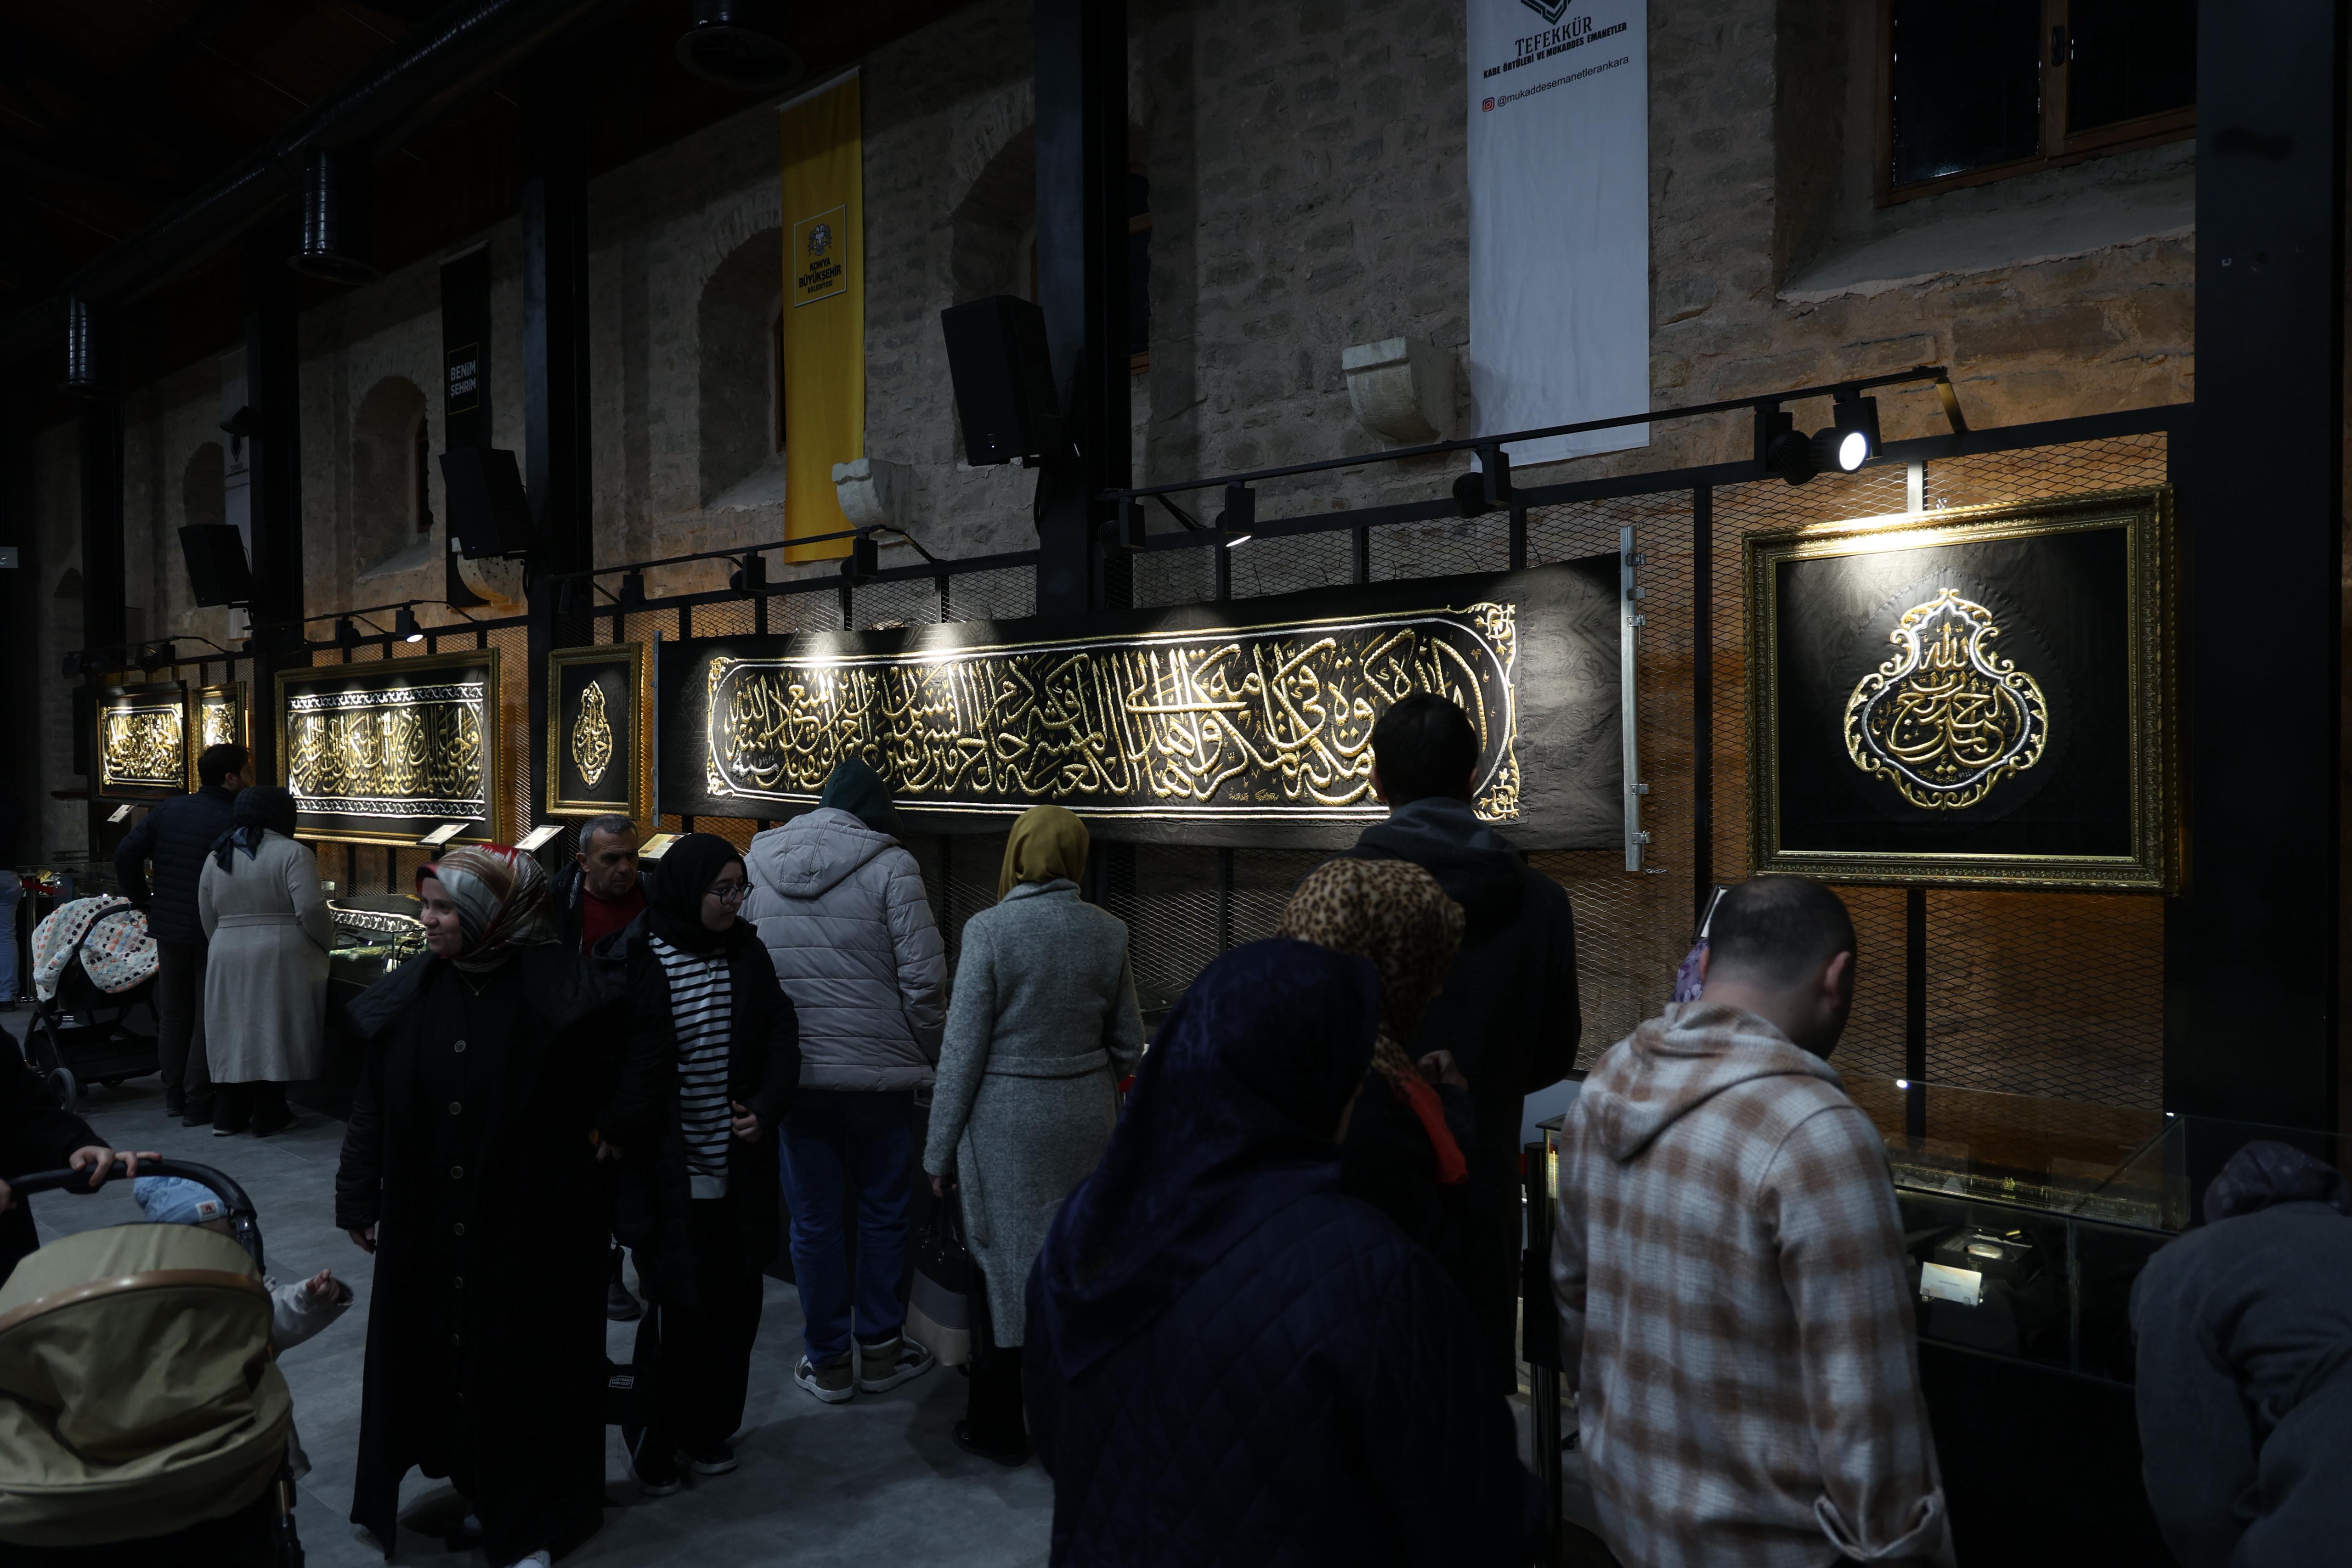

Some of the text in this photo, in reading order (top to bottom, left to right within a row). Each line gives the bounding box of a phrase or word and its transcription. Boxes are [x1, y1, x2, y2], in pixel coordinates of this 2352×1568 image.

[1483, 22, 1627, 79] KABE ÖRTÜLERİ VE MUKADDES EMANETLER
[1515, 17, 1592, 56] TEFEKKÜR
[1497, 56, 1629, 107] @mukaddesemanetlerankara
[809, 257, 831, 271] KONYA
[808, 278, 833, 293] BELEDİYESİ
[450, 377, 476, 399] ŞEHRİM
